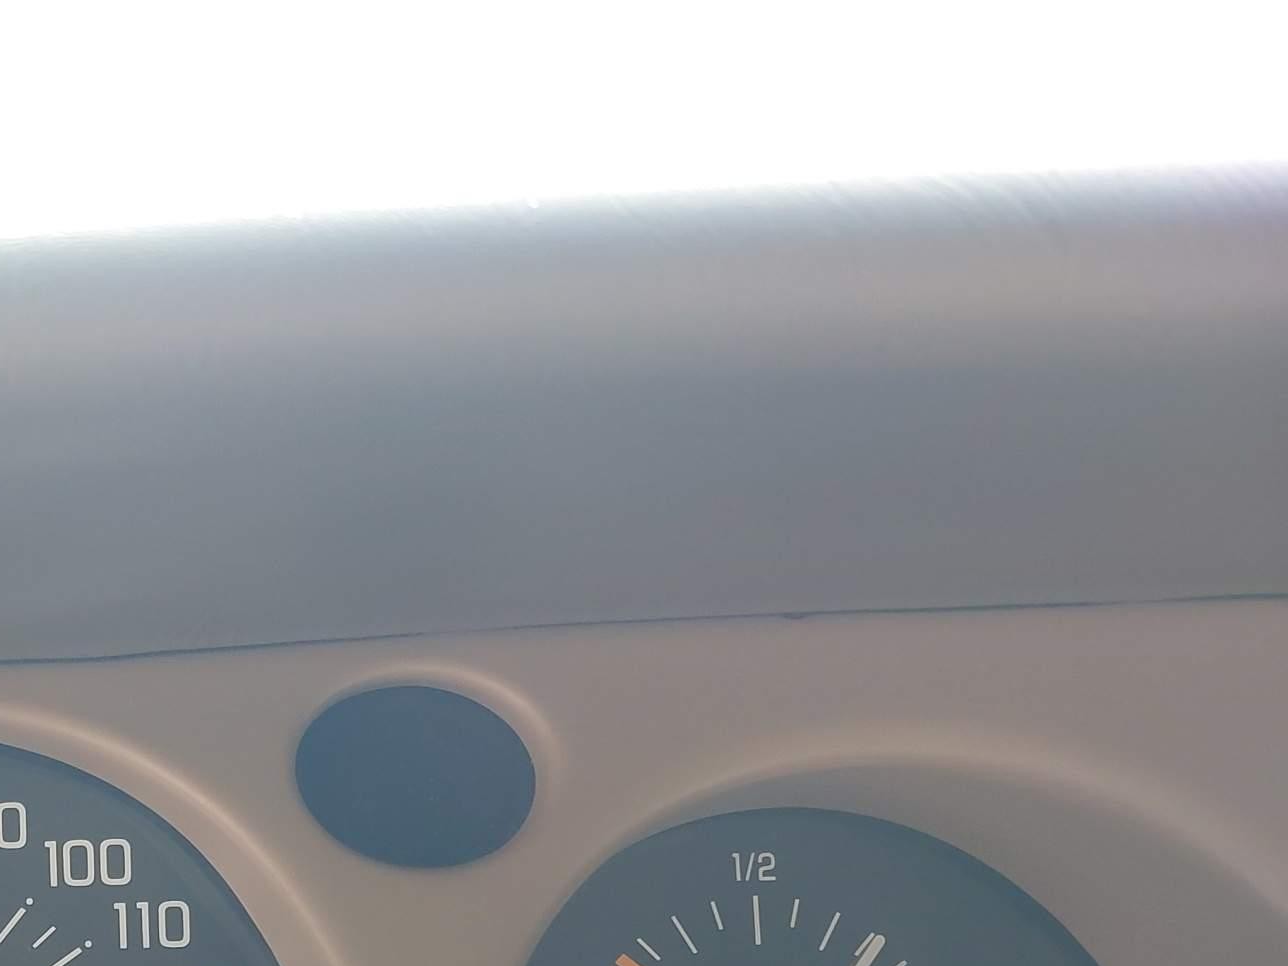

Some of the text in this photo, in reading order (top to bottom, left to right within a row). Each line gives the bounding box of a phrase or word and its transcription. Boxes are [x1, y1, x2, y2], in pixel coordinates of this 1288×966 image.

[45, 839, 131, 886] 100
[732, 853, 776, 881] 1/2
[114, 901, 190, 948] 110
